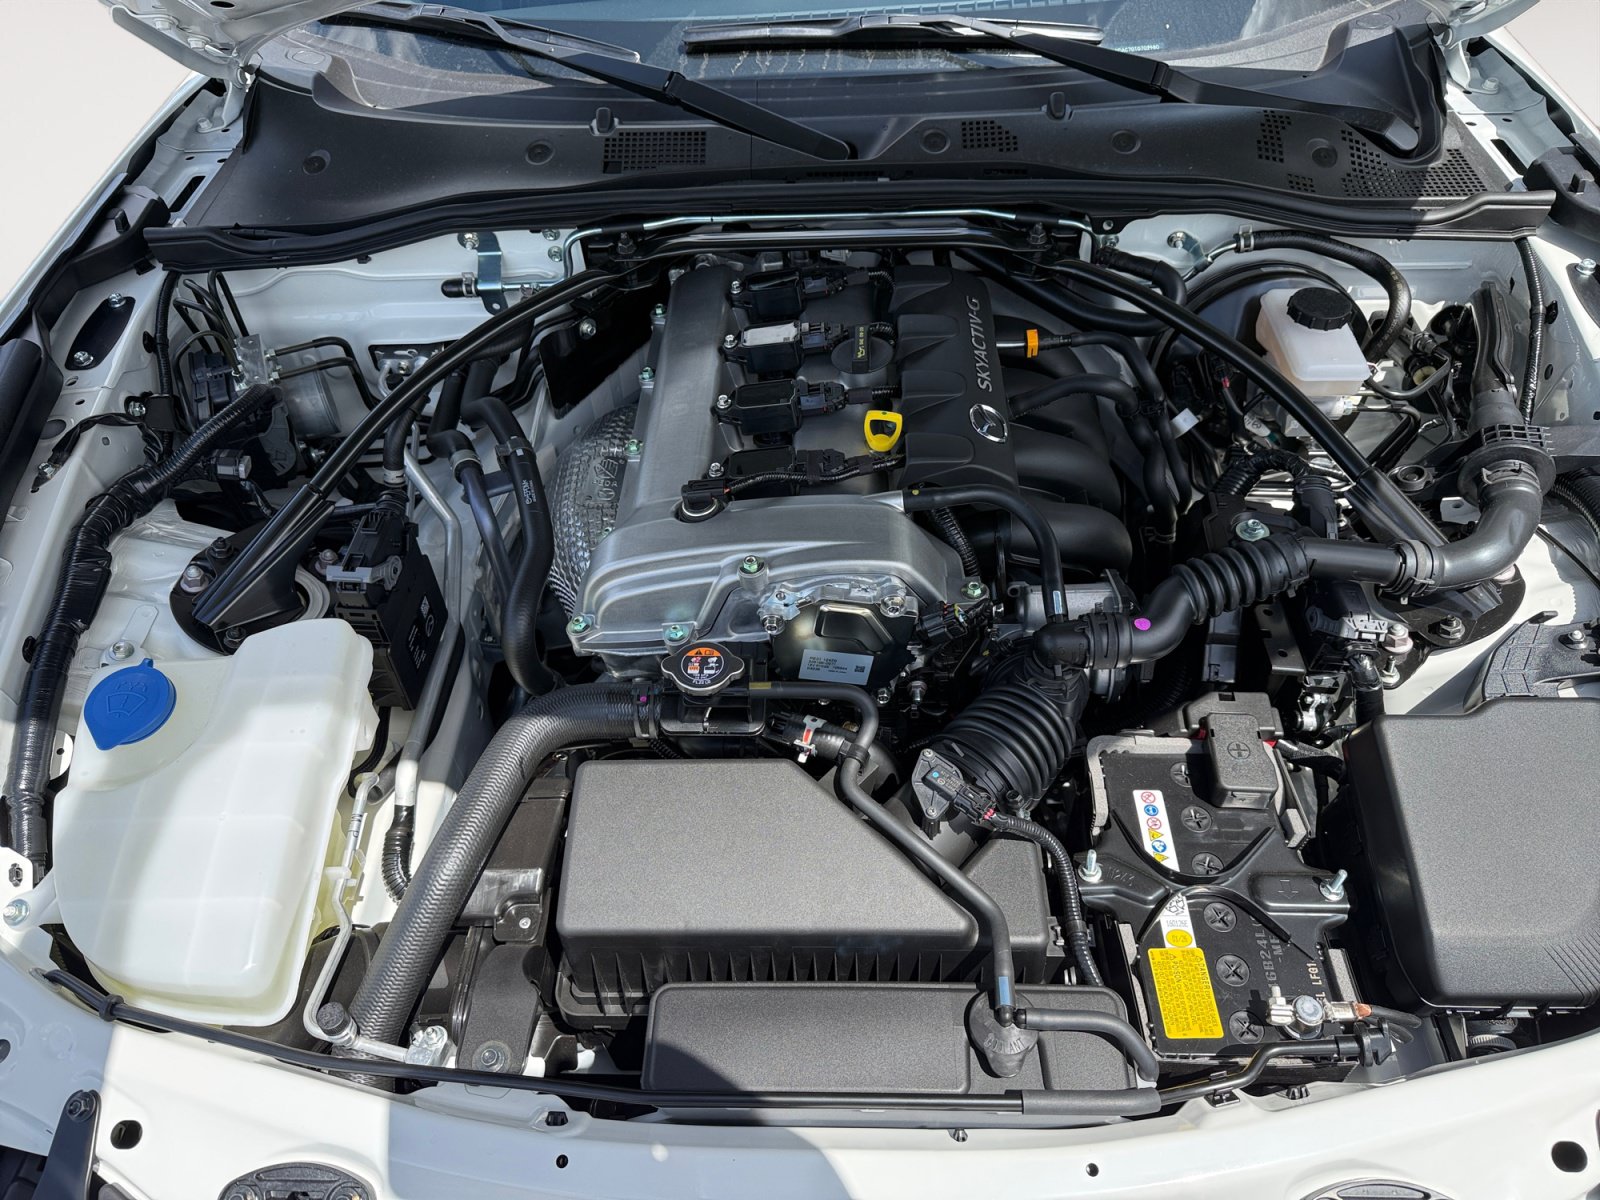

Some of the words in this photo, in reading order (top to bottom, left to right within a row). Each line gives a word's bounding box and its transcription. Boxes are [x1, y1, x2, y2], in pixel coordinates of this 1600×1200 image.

[966, 295, 993, 392] SKYACTIV-G
[1172, 961, 1181, 982] POISON
[1198, 963, 1210, 989] DANGER
